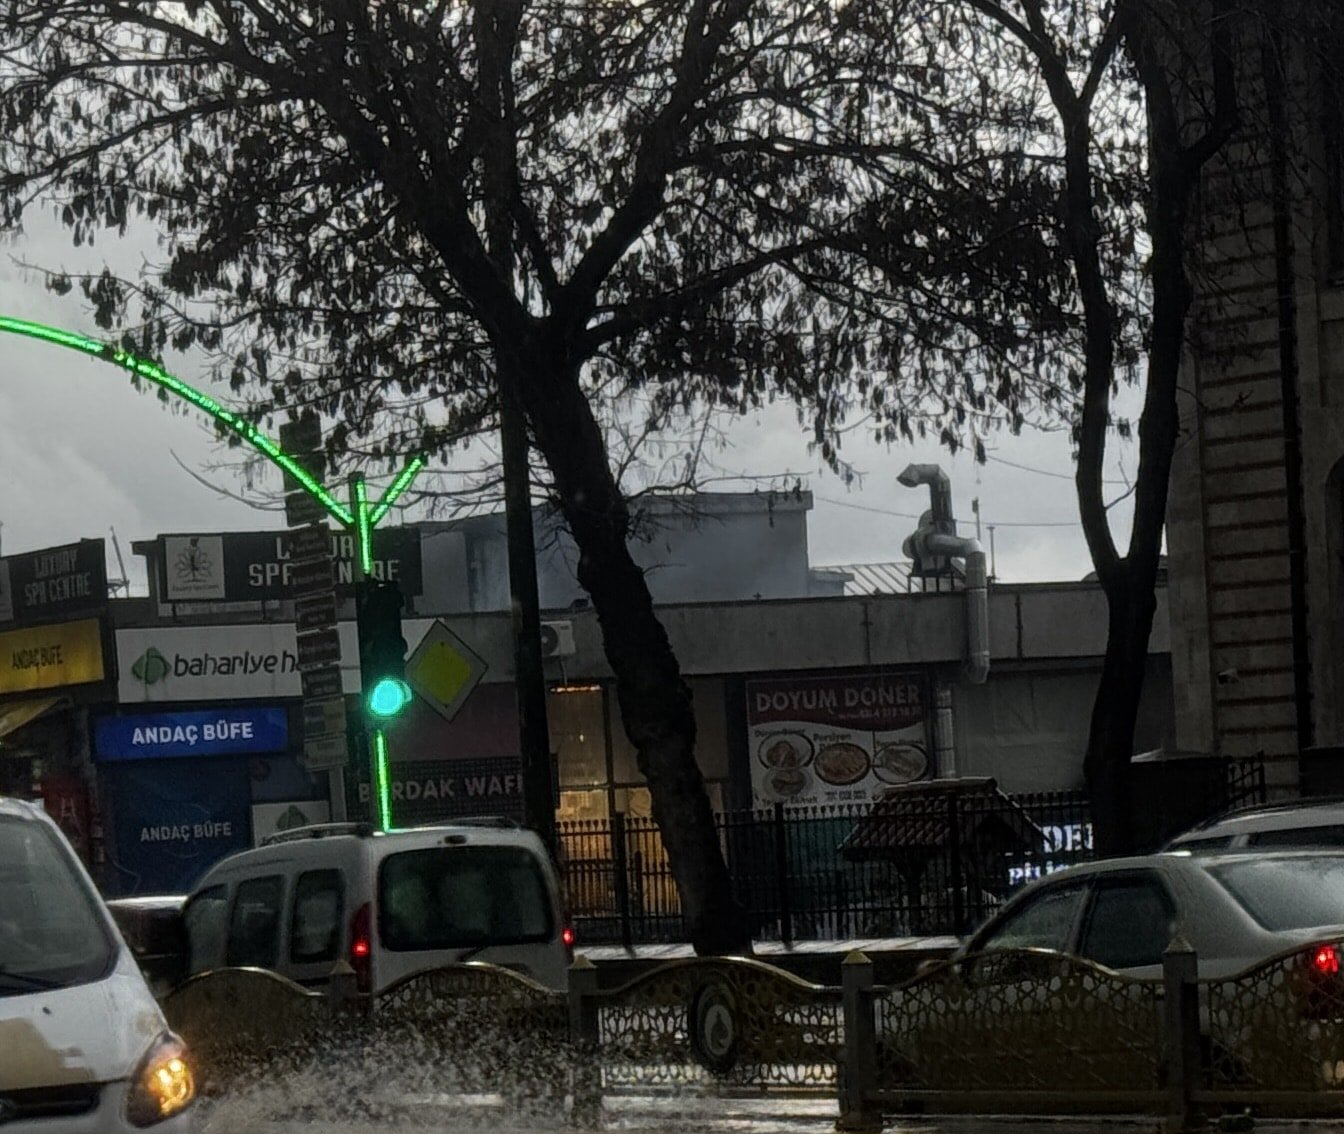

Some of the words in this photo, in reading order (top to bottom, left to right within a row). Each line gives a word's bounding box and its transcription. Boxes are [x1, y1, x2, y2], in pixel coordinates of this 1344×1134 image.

[756, 688, 838, 713] DOYUM
[843, 681, 920, 707] DÖNER
[132, 724, 199, 747] ANDAÇ
[202, 718, 255, 741] BÜFE
[358, 778, 456, 803] BRDAK
[140, 825, 191, 843] ANDAÇ
[193, 820, 233, 839] BÜFE
